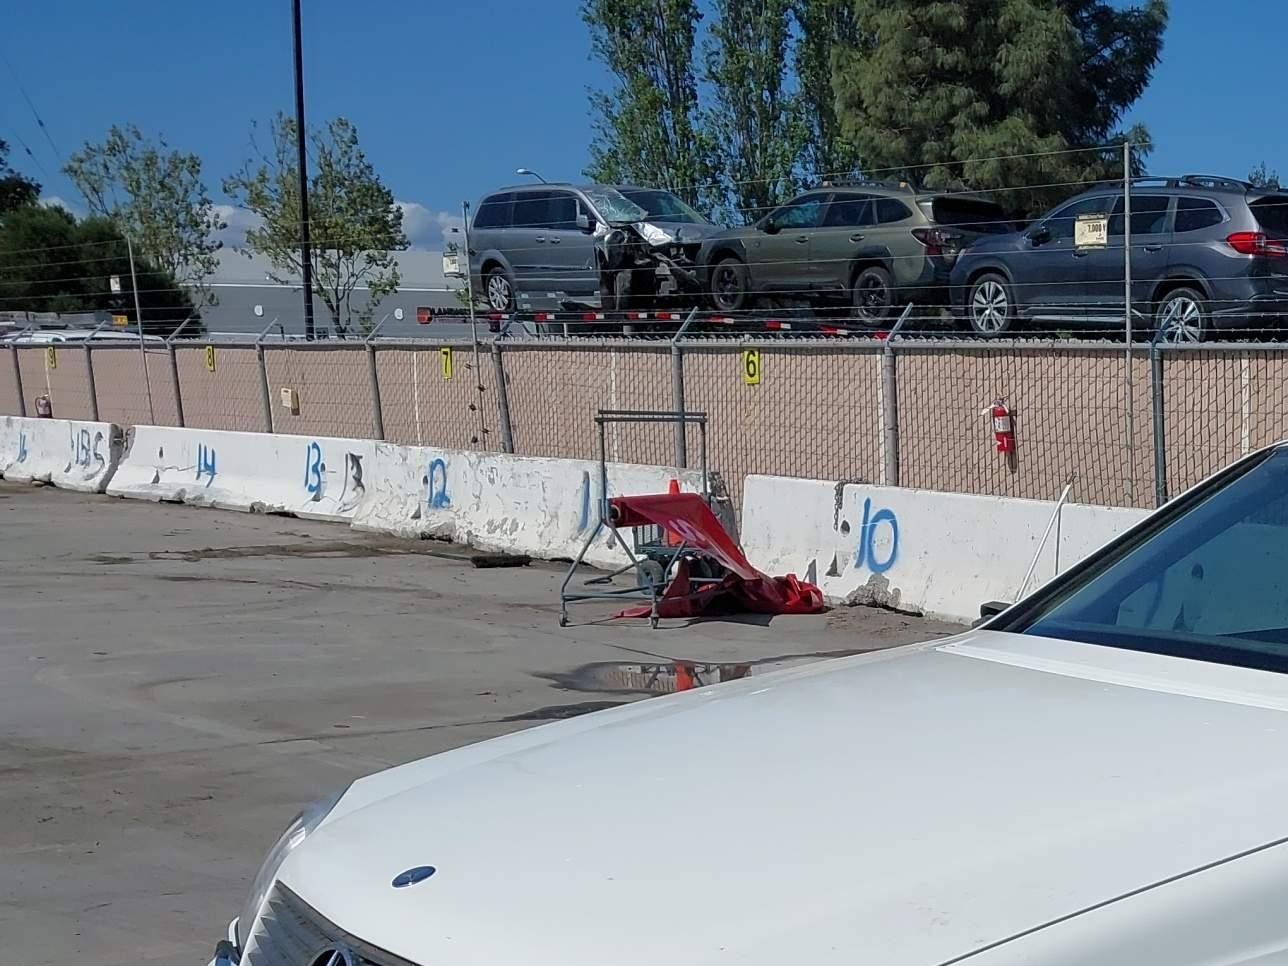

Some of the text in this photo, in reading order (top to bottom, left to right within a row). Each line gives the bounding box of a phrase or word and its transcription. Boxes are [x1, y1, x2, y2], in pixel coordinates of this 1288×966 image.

[442, 350, 449, 374] 7
[746, 350, 757, 378] 6
[195, 442, 218, 488] 14
[304, 441, 321, 493] 13
[854, 497, 899, 574] 10
